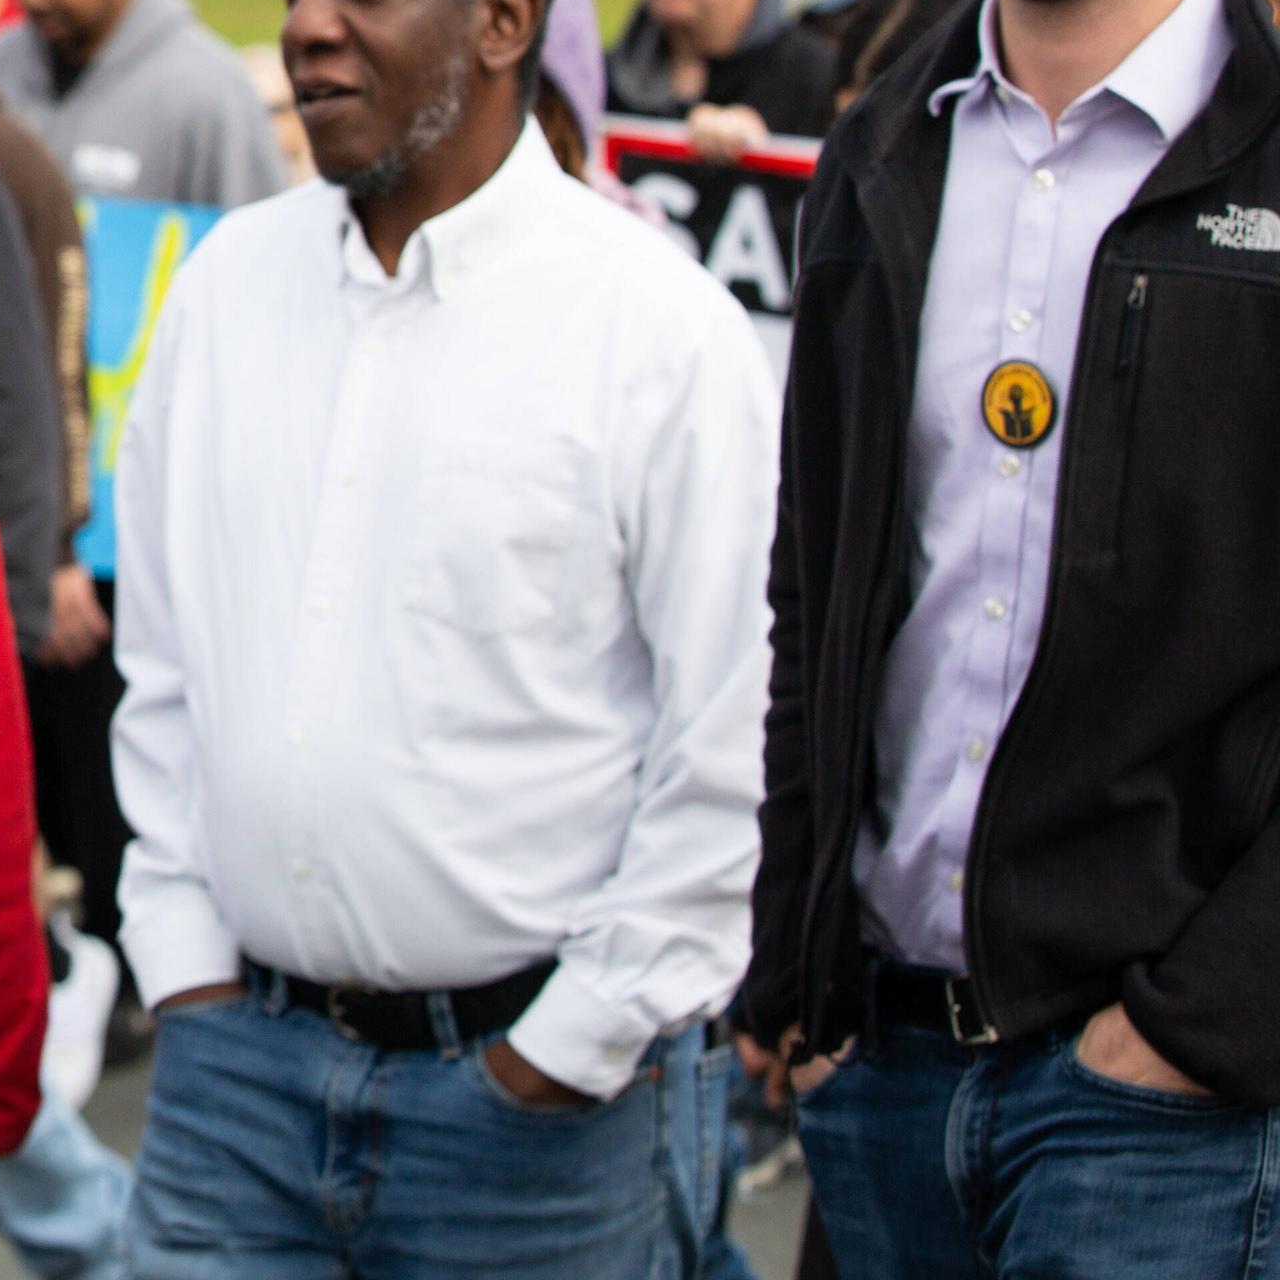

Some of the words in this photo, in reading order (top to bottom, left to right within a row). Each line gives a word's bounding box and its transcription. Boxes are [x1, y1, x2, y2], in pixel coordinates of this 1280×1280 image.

[1225, 203, 1259, 223] THE
[1196, 212, 1259, 239] NORTH
[1210, 228, 1259, 251] FACE
